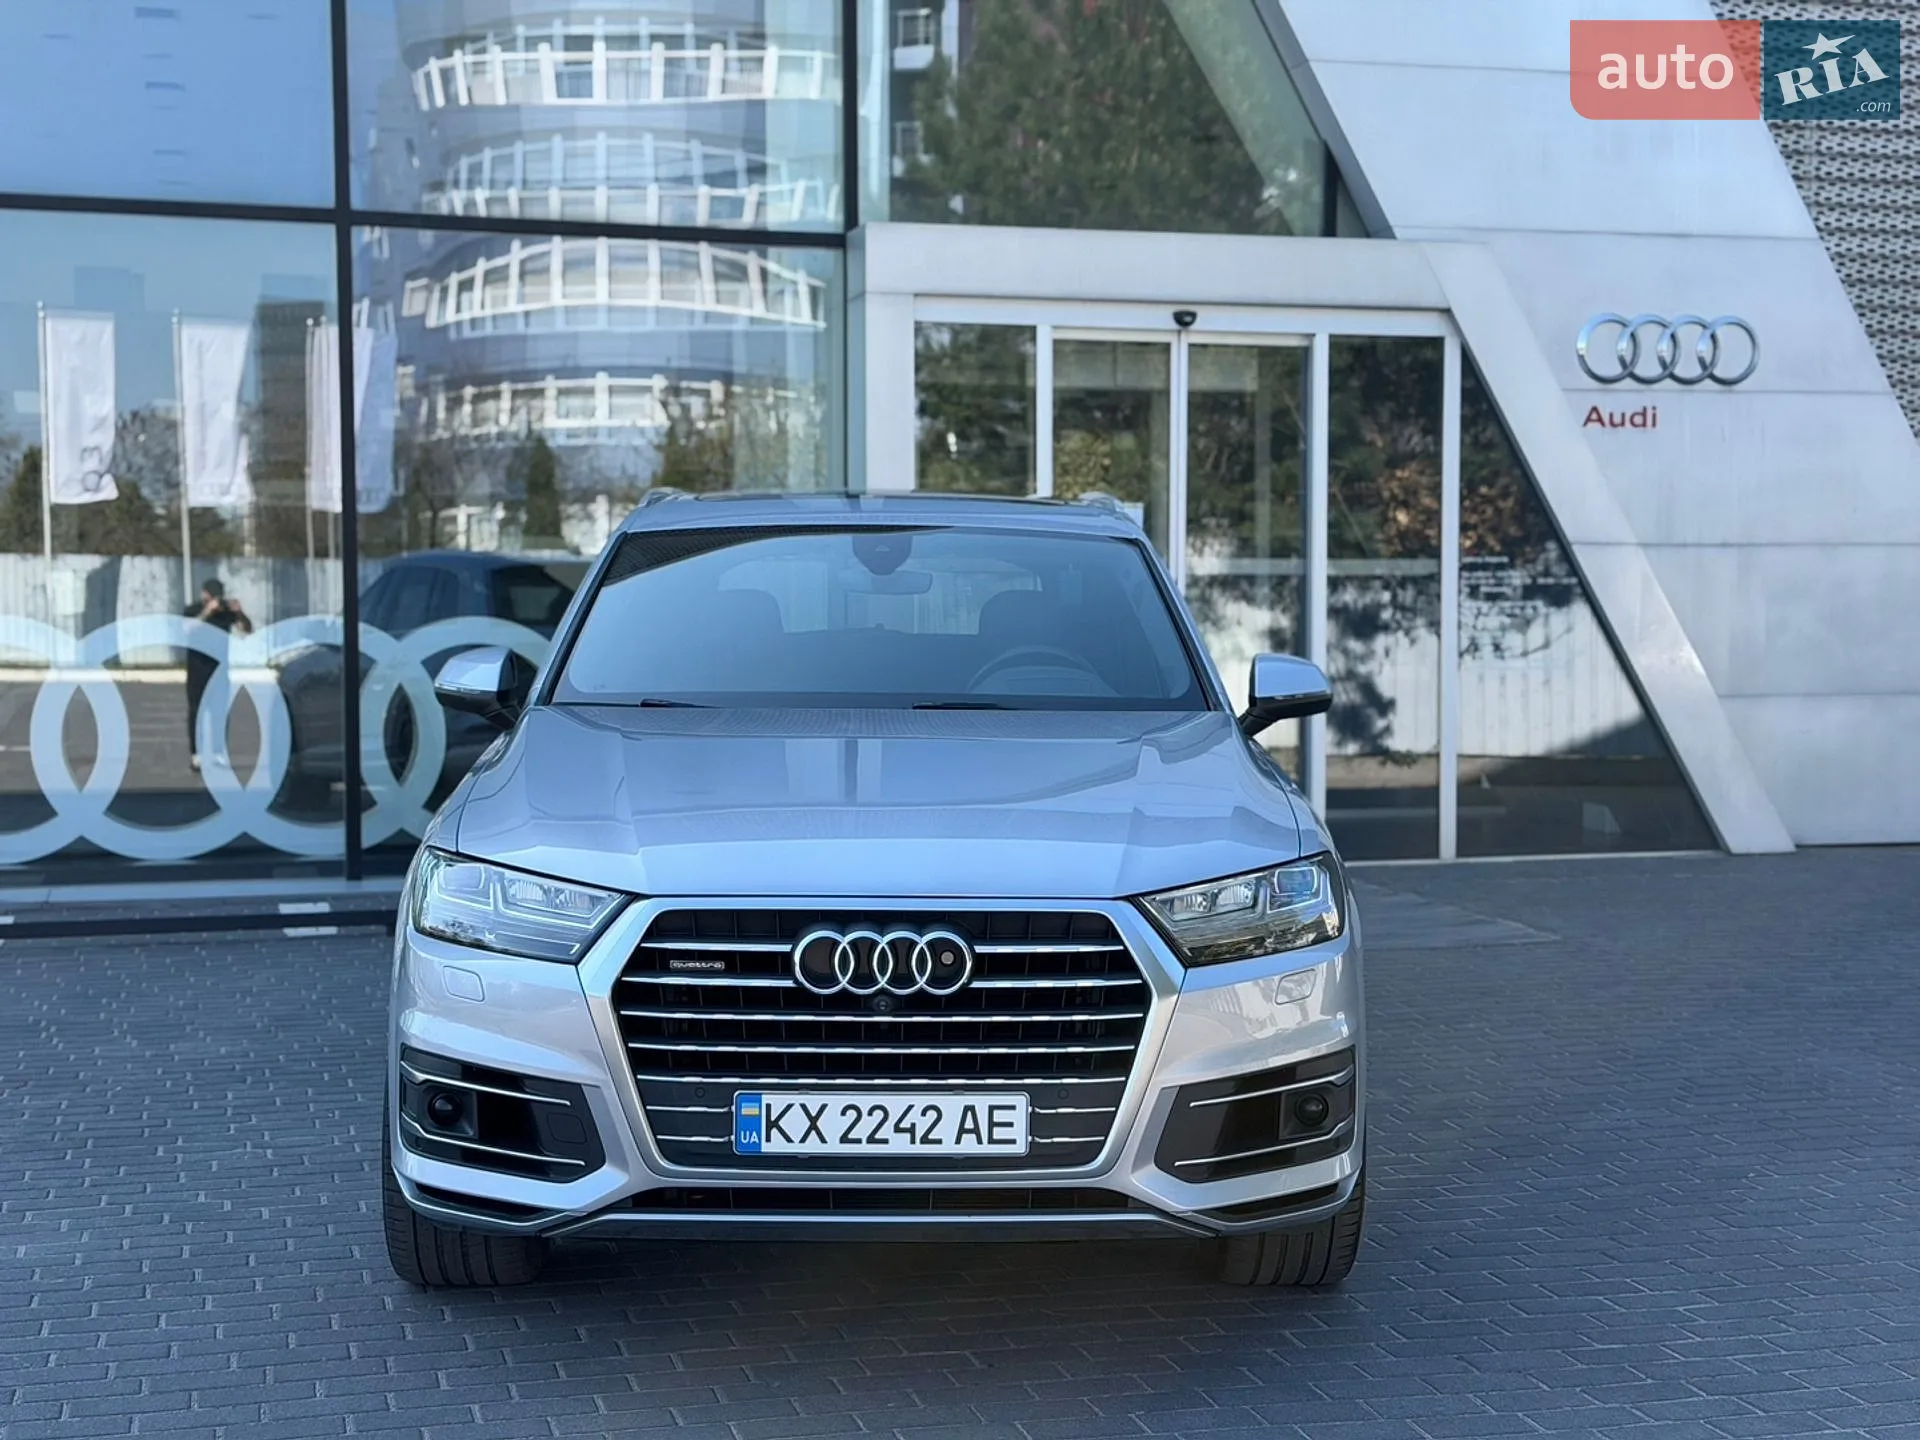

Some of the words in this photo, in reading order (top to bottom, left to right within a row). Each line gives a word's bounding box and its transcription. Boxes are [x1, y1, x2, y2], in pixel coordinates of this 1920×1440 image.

[1582, 405, 1657, 428] Audi
[764, 1102, 829, 1144] KX
[838, 1103, 944, 1145] 2242
[953, 1103, 1018, 1145] AE
[740, 1130, 759, 1144] UA
